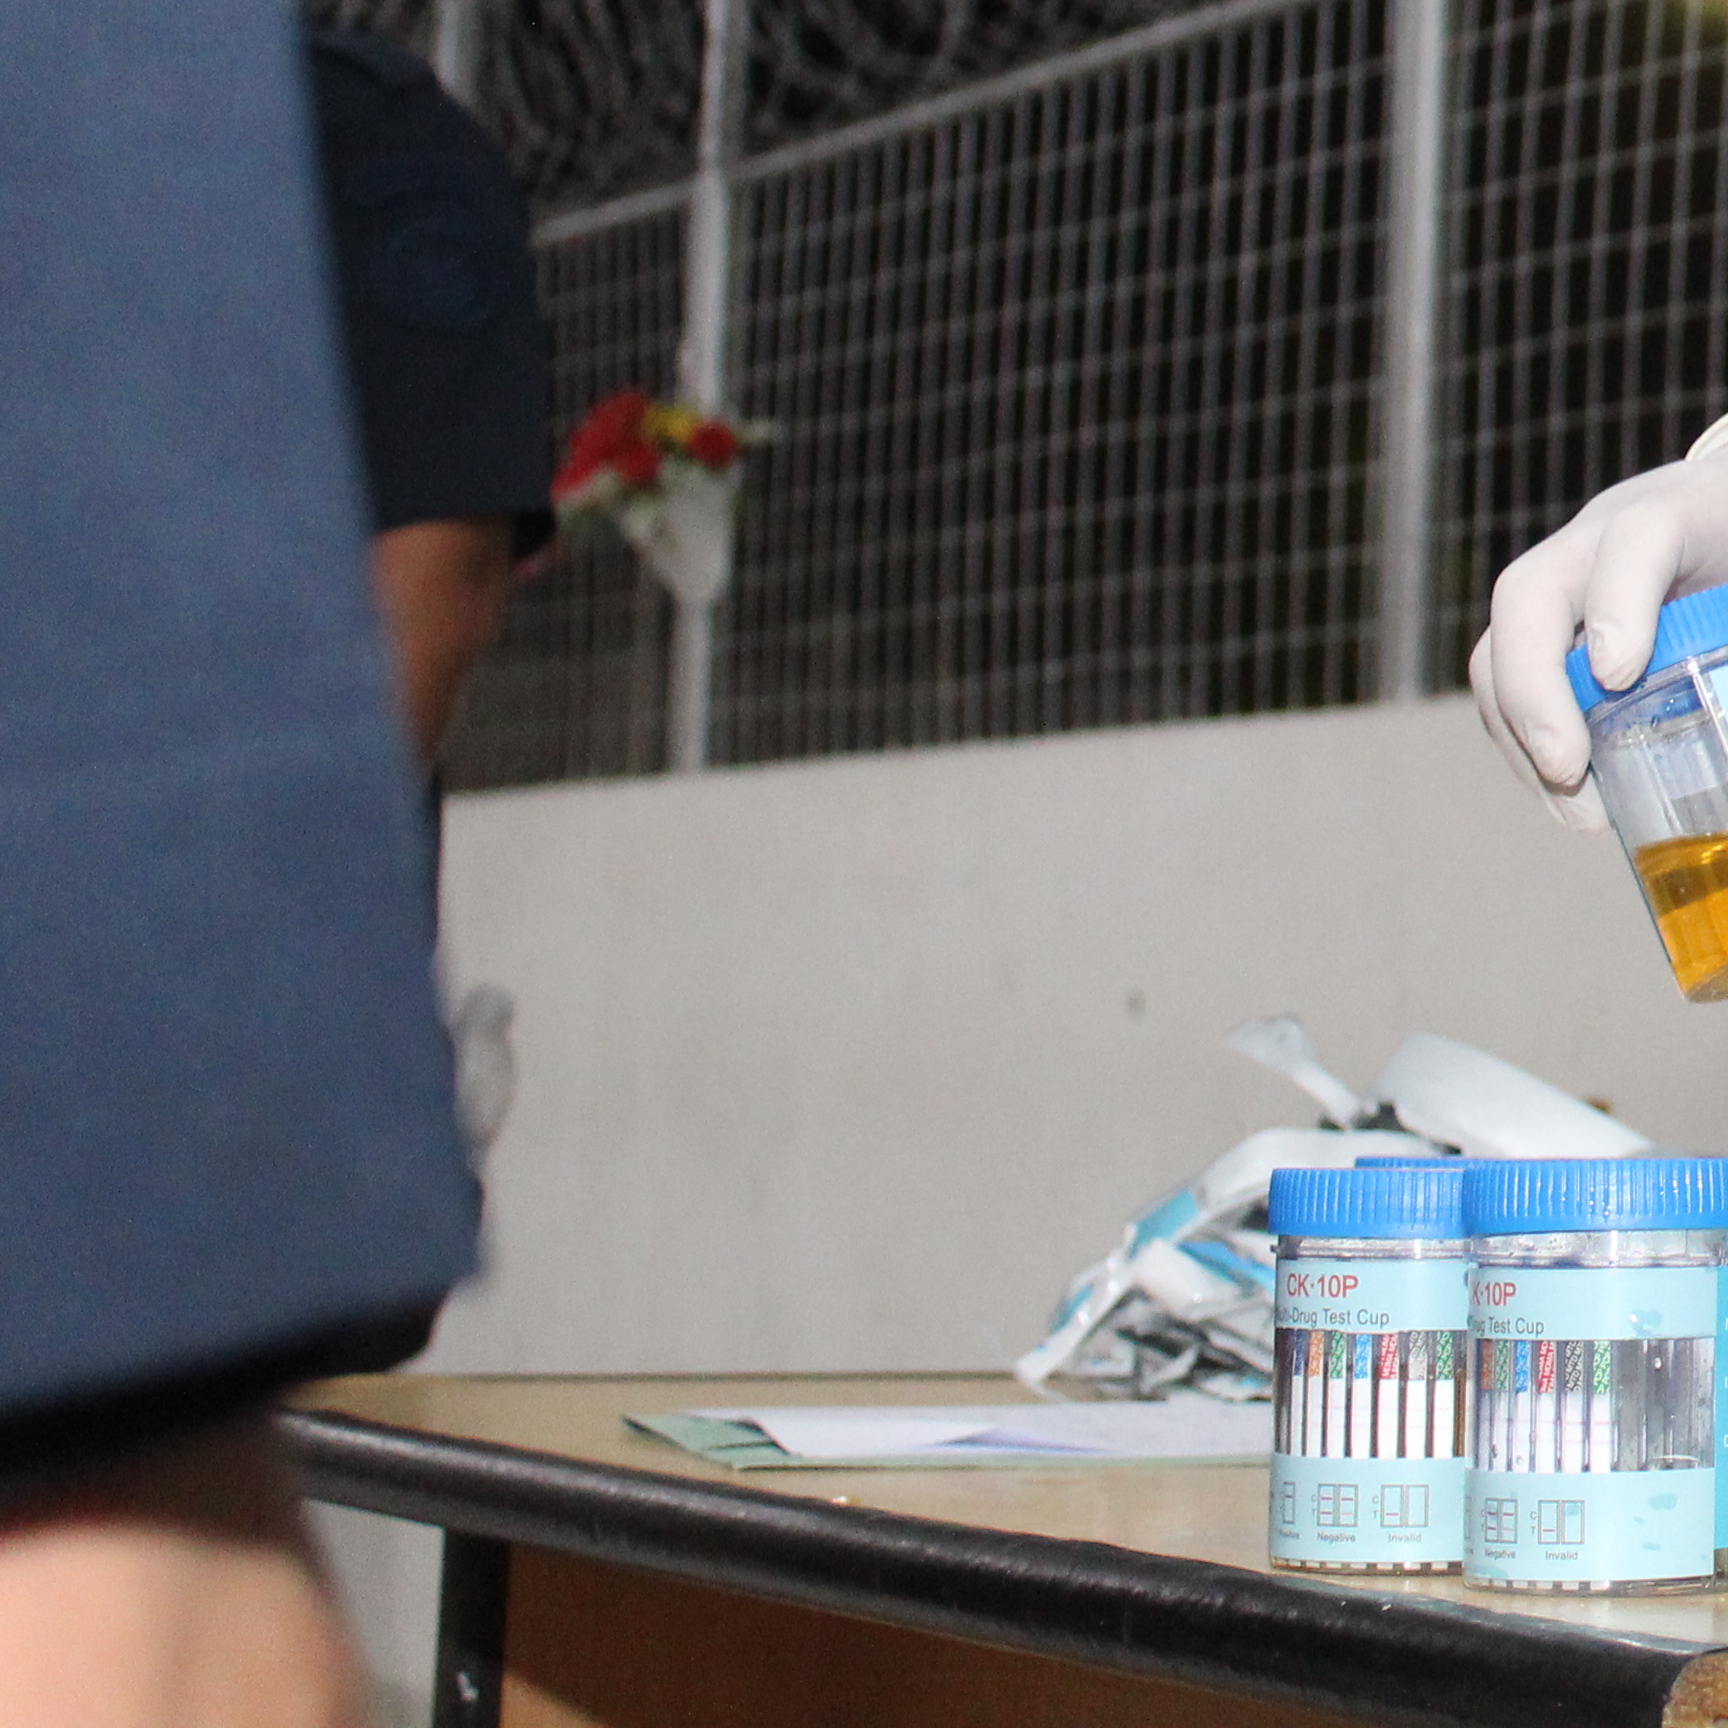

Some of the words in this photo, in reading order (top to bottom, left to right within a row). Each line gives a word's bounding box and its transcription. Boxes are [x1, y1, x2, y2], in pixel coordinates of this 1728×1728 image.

[1323, 1308, 1351, 1325] Test
[1357, 1309, 1390, 1328] Cup
[1489, 1316, 1511, 1334] Test
[1515, 1317, 1544, 1338] Cup
[1317, 1531, 1356, 1546] Negative
[1388, 1533, 1422, 1543] Invalid
[1545, 1551, 1578, 1561] Invalid
